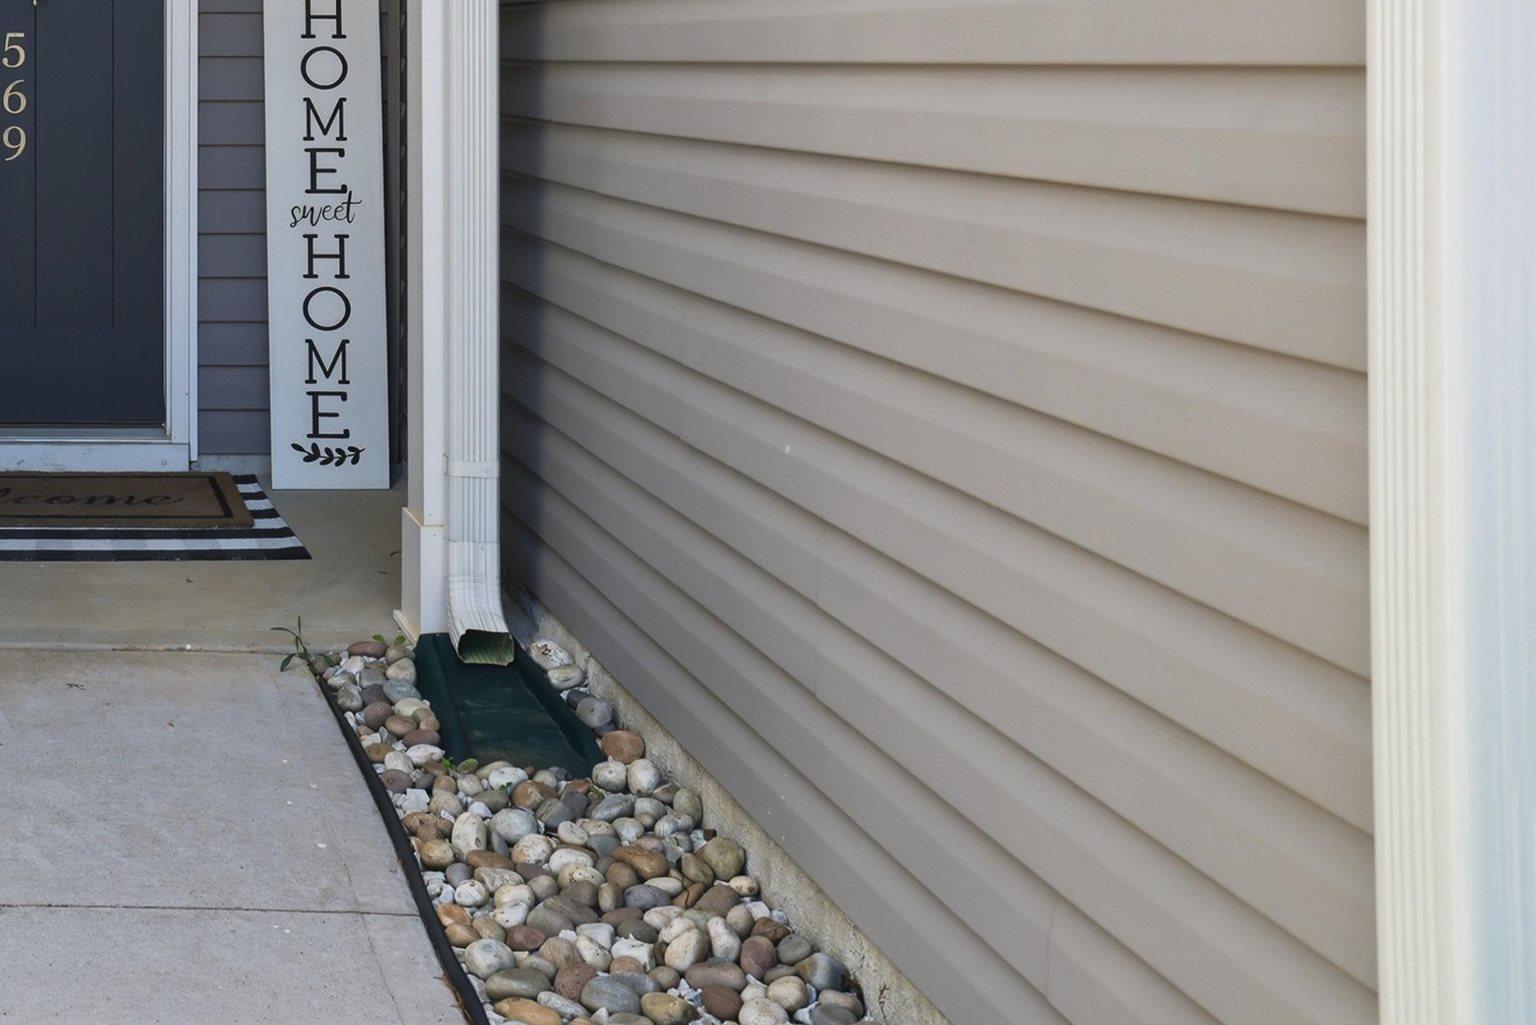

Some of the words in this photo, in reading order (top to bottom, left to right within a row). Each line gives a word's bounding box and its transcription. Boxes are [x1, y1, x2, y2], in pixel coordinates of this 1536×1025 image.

[2, 32, 27, 162] 569
[290, 190, 363, 228] sweet
[303, 234, 351, 439] HOME
